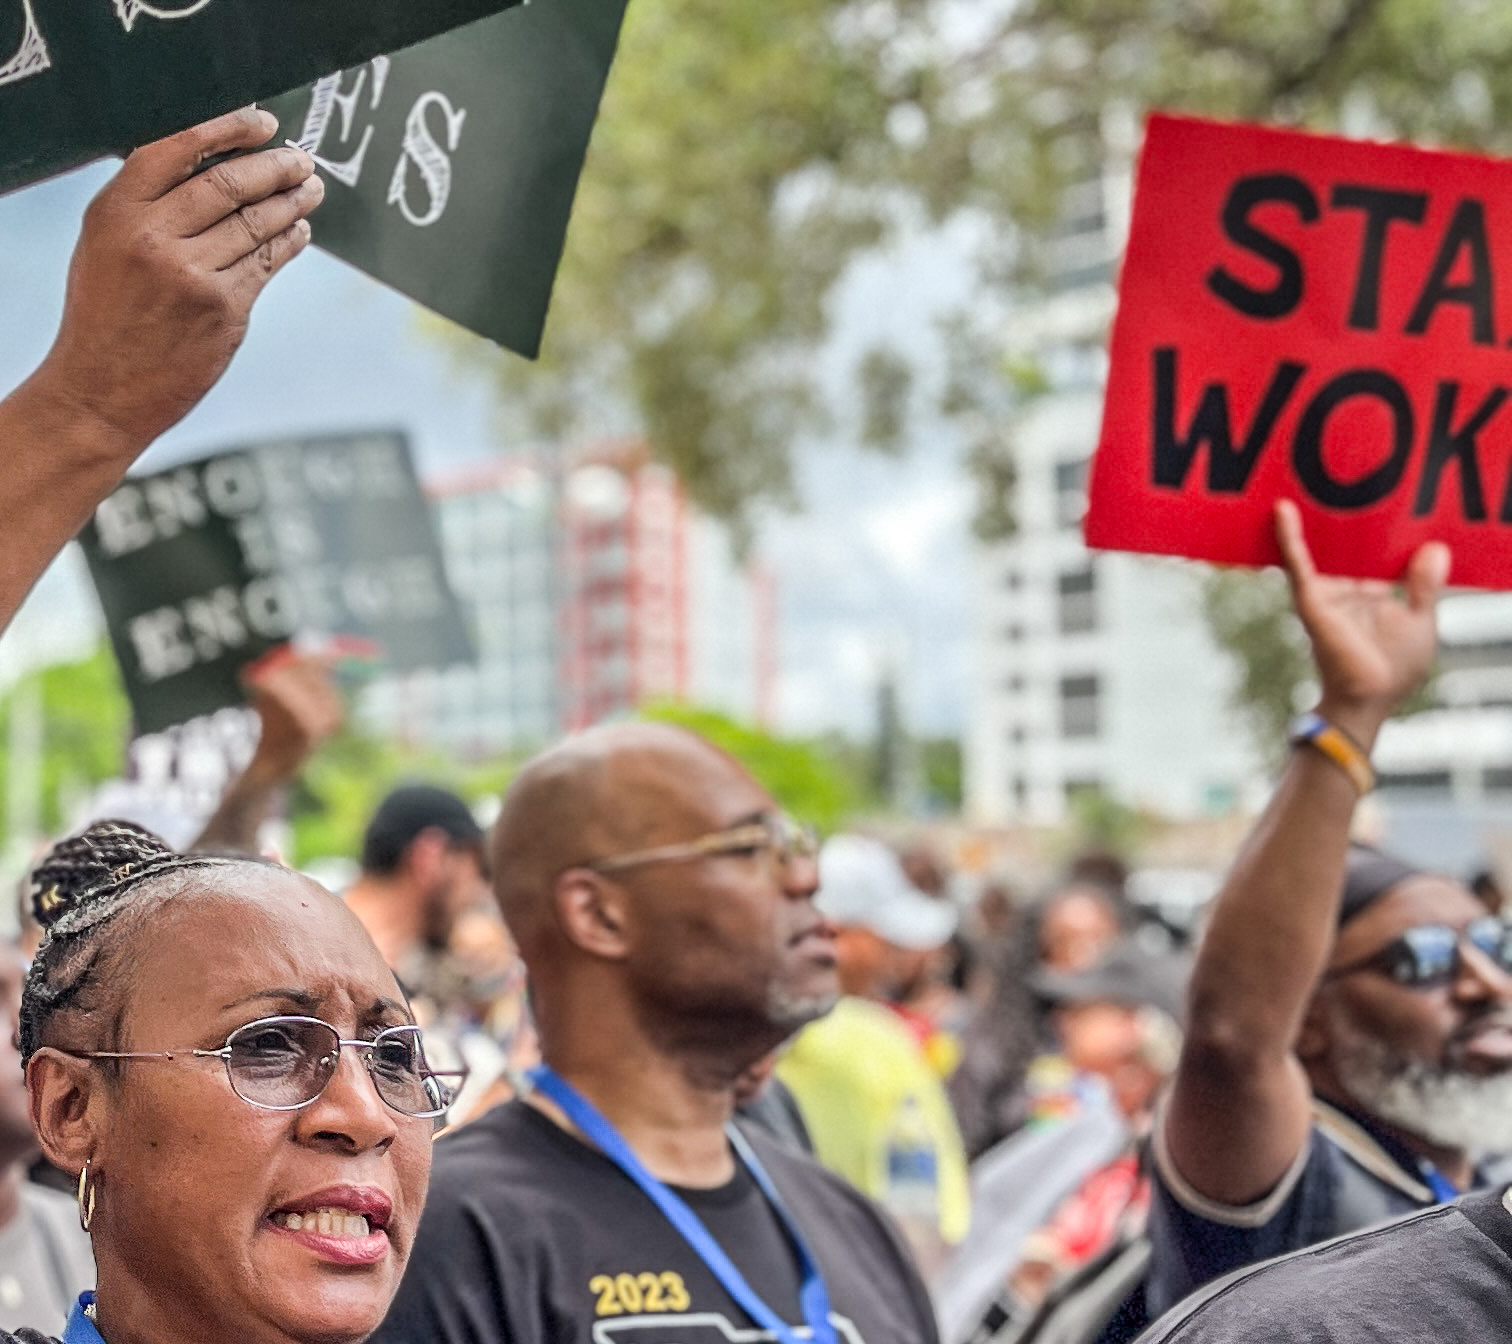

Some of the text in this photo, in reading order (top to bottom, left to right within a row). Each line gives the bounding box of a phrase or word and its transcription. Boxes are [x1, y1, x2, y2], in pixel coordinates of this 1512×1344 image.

[1206, 170, 1512, 350] STA
[1151, 346, 1512, 525] WOK
[590, 1270, 690, 1315] 2023
